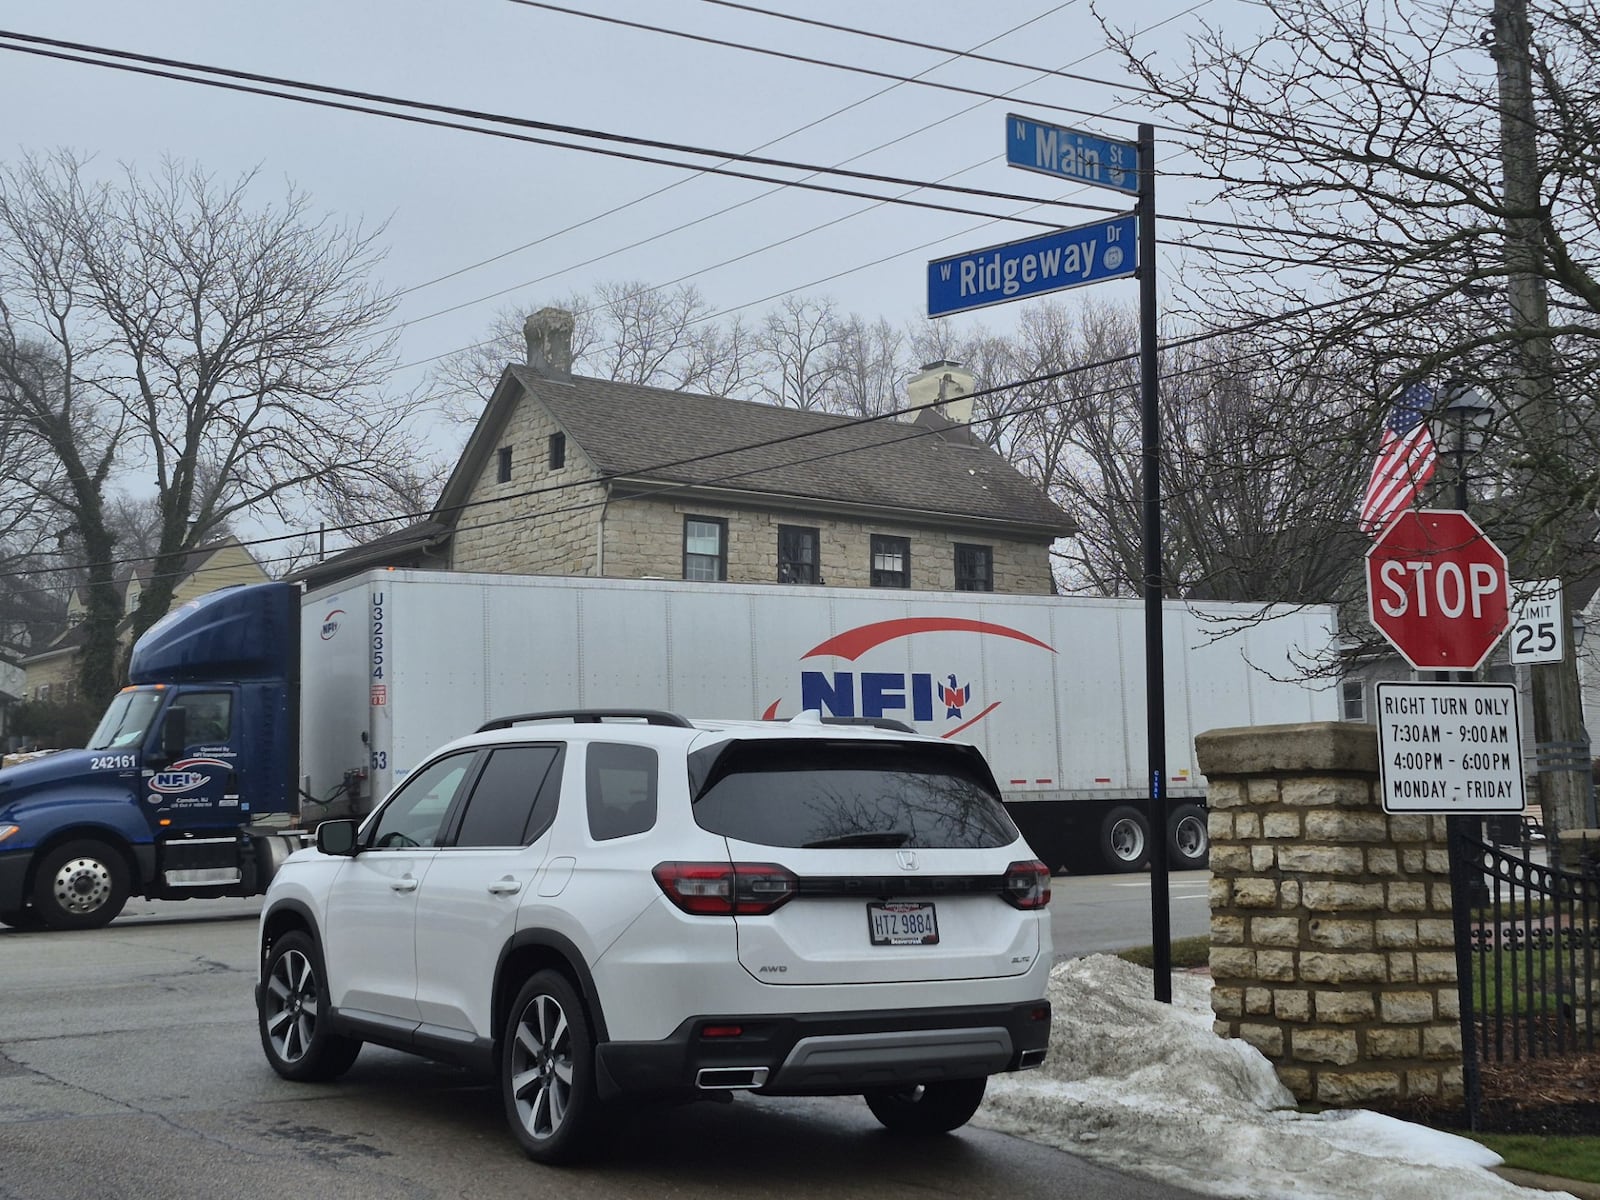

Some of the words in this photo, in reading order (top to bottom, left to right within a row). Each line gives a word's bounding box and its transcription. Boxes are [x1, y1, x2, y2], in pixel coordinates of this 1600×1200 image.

[1016, 122, 1026, 141] N
[1035, 127, 1101, 180] Main
[1109, 144, 1123, 164] St
[940, 263, 952, 281] W
[960, 239, 1097, 298] Ridgeway
[1106, 224, 1122, 243] Dr
[1380, 559, 1498, 619] STOP
[1513, 587, 1557, 604] SEED
[372, 592, 384, 680] U32354
[1515, 622, 1557, 654] 25
[801, 671, 934, 721] NFI
[1385, 696, 1426, 715] RIGHT
[1431, 697, 1468, 716] TURN
[1474, 698, 1509, 716] ONLY
[91, 755, 136, 769] 242161
[371, 751, 387, 769] 53
[158, 774, 190, 784] NFI
[1393, 780, 1447, 798] MONDAY
[1466, 780, 1513, 798] FRIDAY
[844, 879, 975, 890] PILOT
[875, 914, 899, 935] HTZ
[901, 914, 932, 934] 9884
[758, 965, 788, 973] AWD
